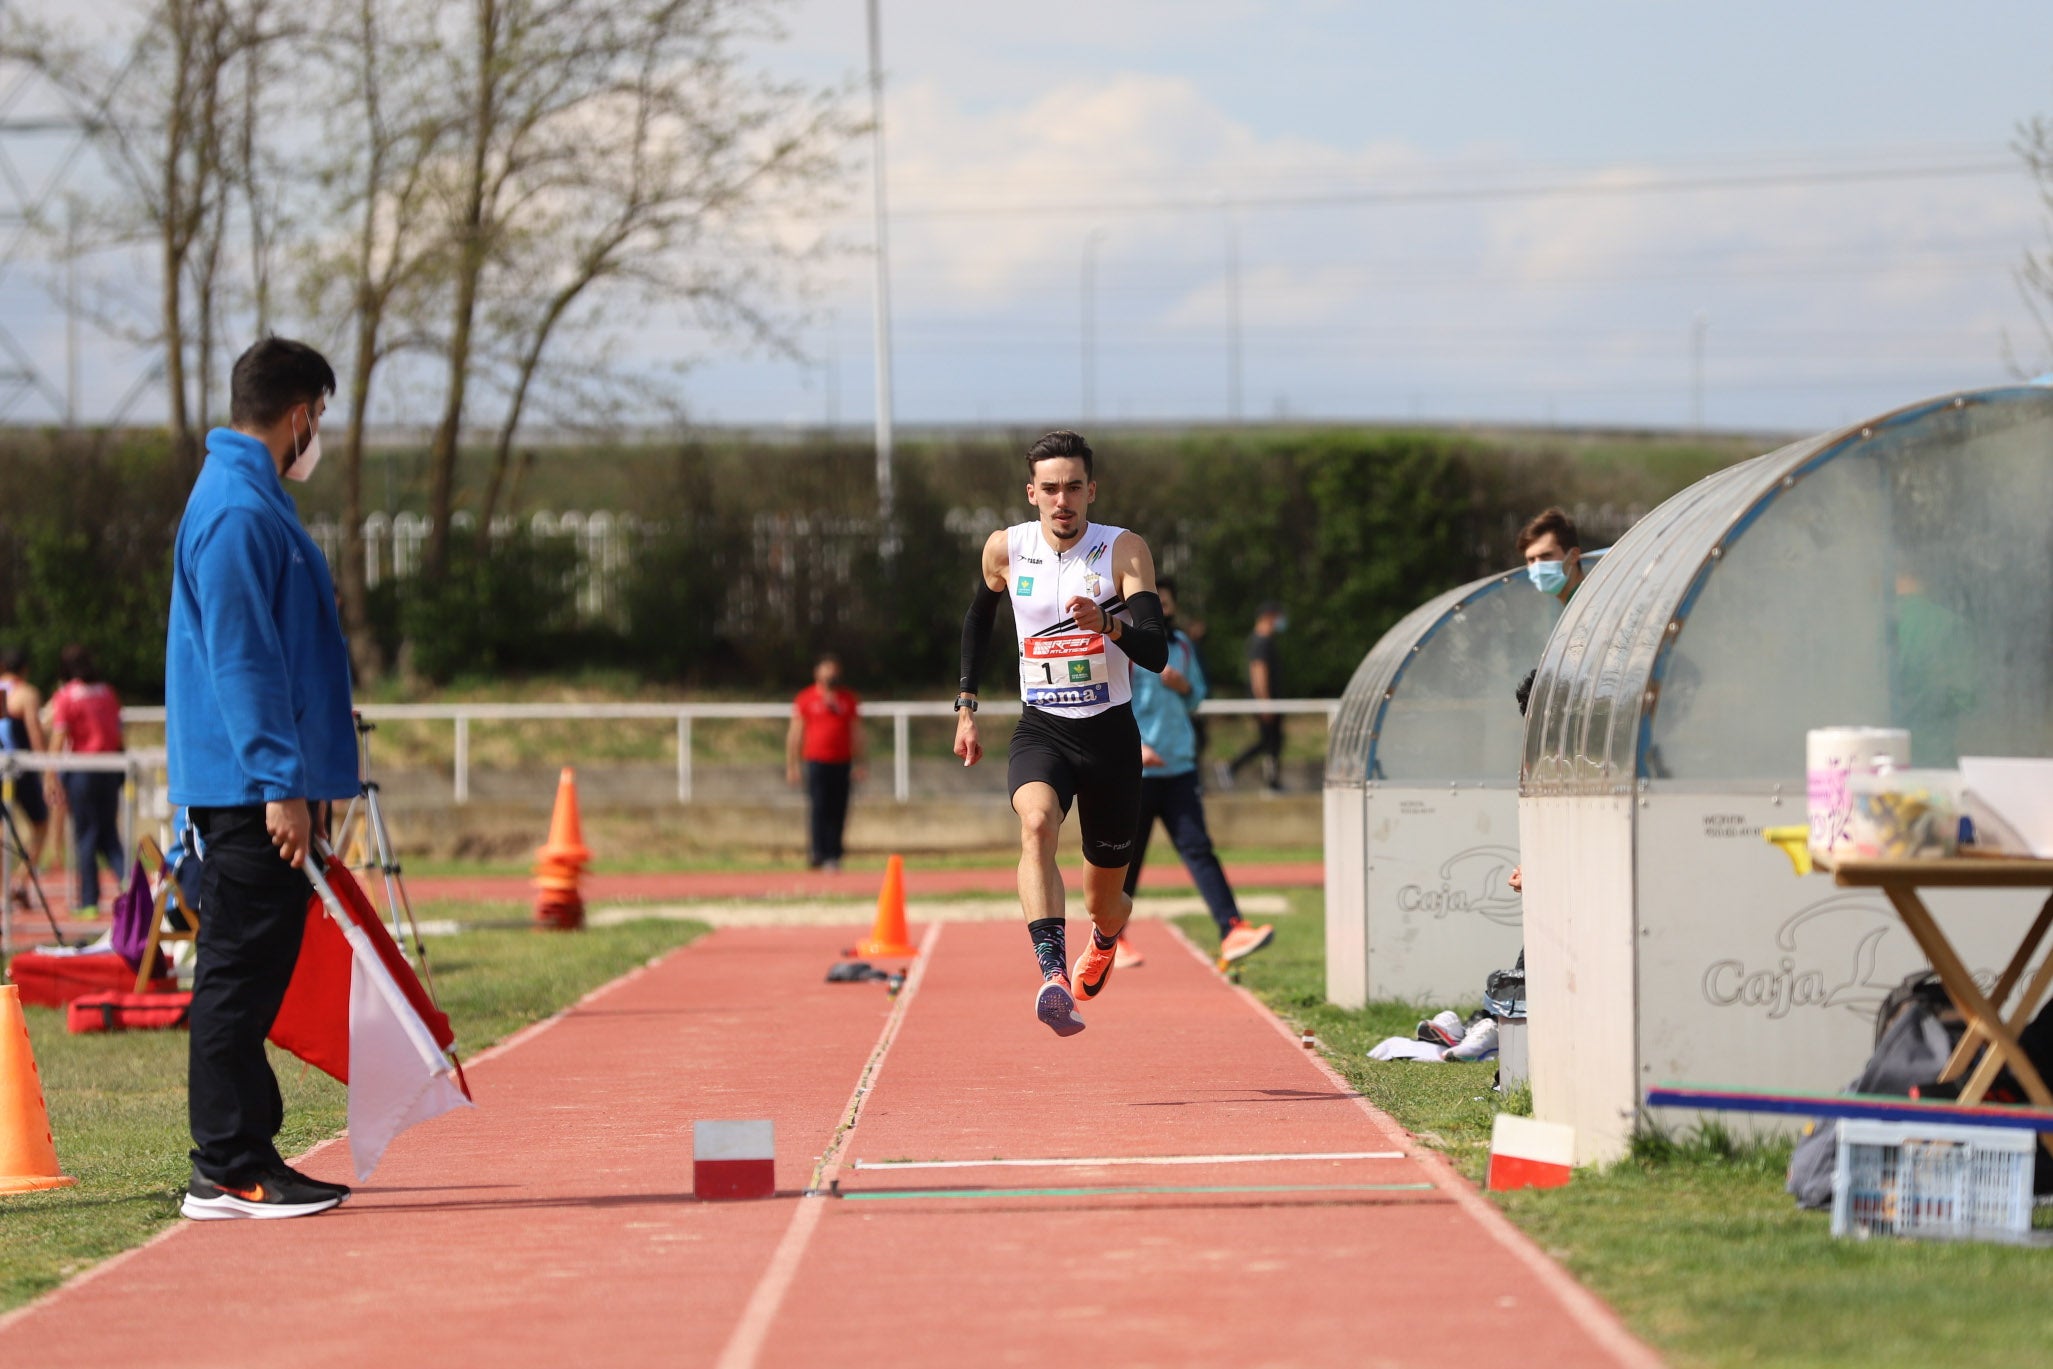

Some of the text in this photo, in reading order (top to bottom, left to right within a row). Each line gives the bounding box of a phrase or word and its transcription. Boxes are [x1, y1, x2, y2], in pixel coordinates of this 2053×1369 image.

[1041, 662, 1053, 684] 1
[1397, 883, 1469, 918] Caja
[1702, 955, 1827, 1019] Caja
